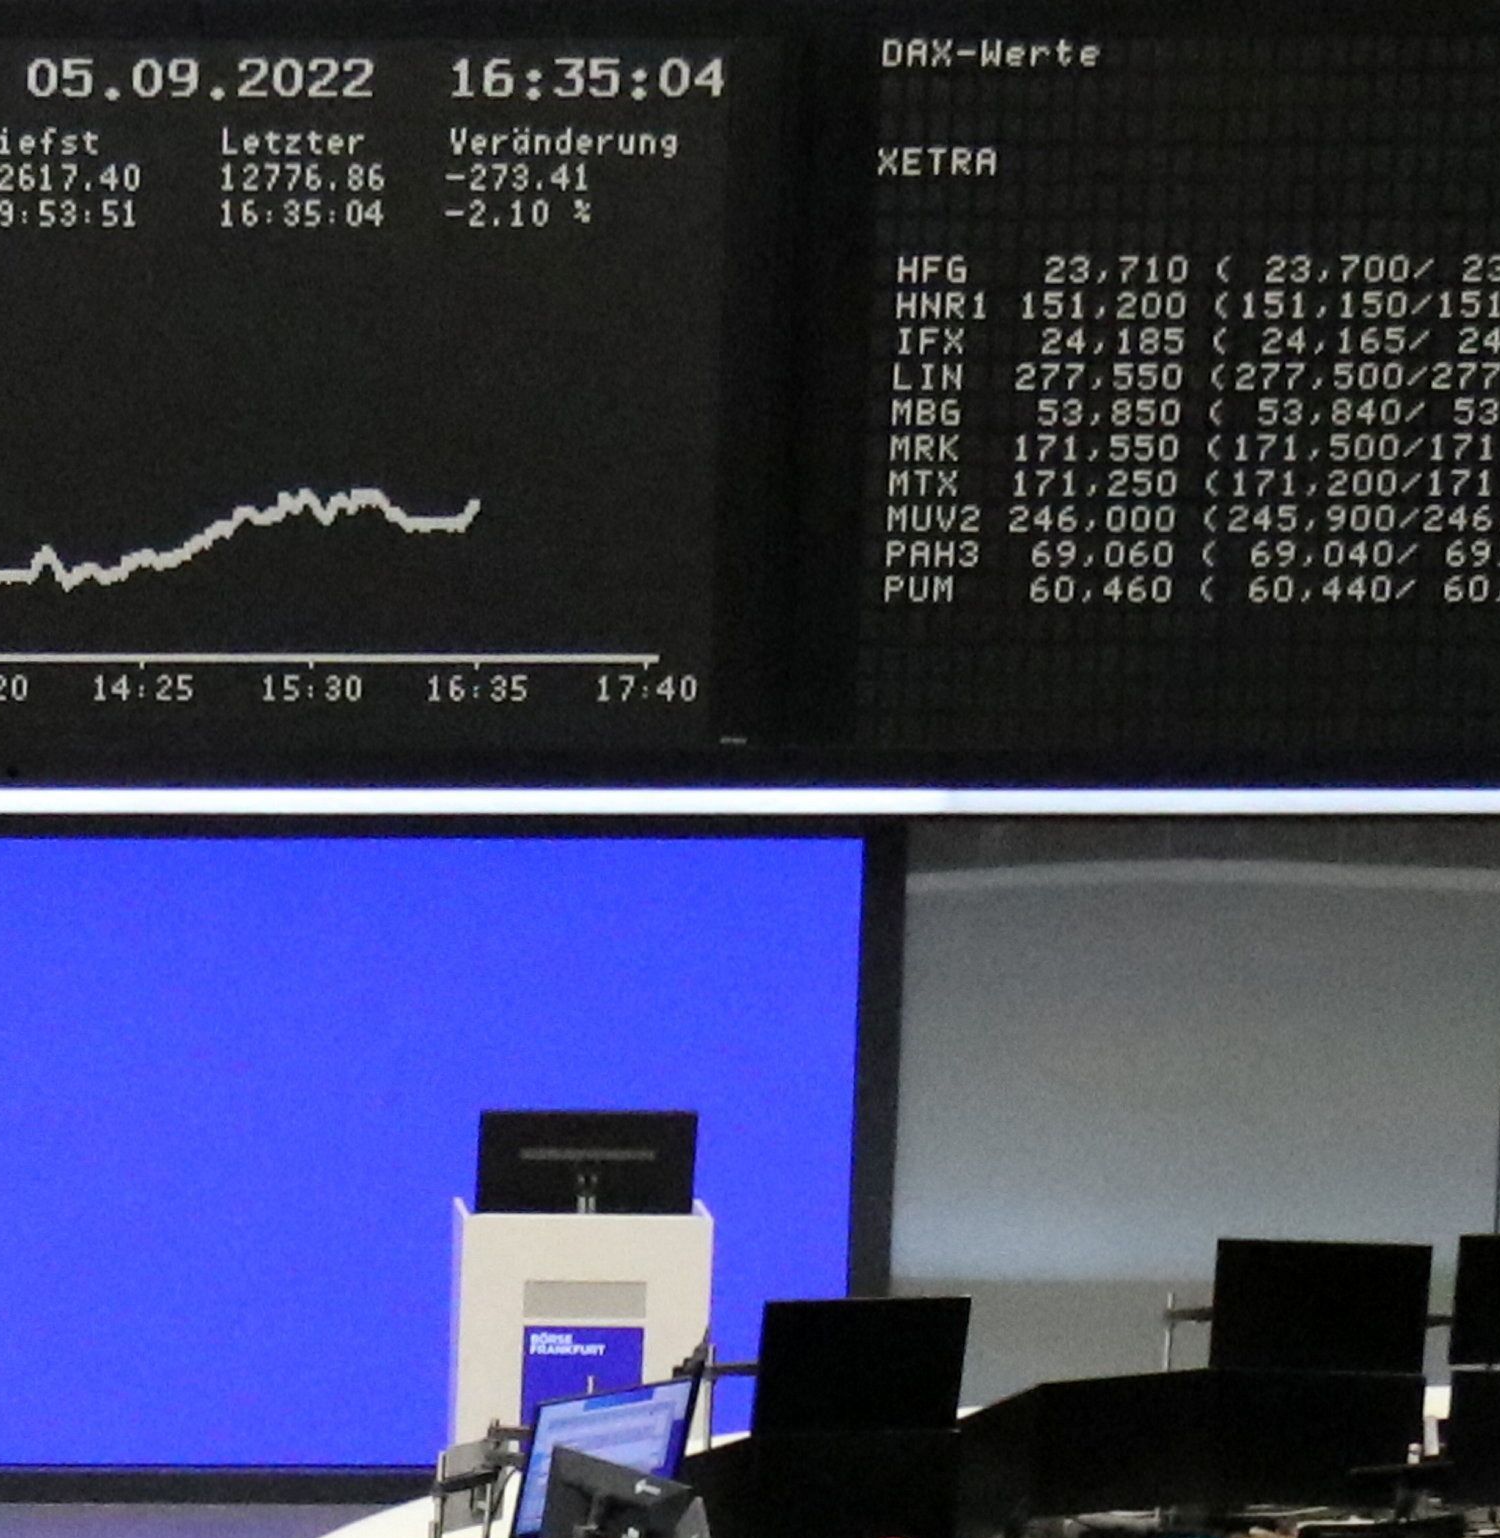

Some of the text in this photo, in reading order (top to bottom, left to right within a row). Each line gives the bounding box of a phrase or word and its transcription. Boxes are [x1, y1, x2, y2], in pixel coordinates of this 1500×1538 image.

[881, 37, 1100, 68] DAX-Werte
[27, 57, 374, 101] 05.09.2022
[451, 57, 725, 101] 16:35:04
[221, 126, 365, 156] Letzter
[450, 126, 678, 159] Veränderung
[877, 146, 997, 176] XETRA
[221, 162, 385, 192] 12776.86
[445, 162, 588, 192] -273.41
[221, 198, 384, 228] 16:35:04
[444, 198, 549, 228] -2.10
[573, 198, 591, 224] %
[897, 254, 1189, 284] HFG 23,710
[896, 291, 986, 320] HNR1
[1022, 290, 1187, 320] 151,200
[898, 326, 1185, 355] IFX 24,185
[892, 362, 963, 391] LIN
[1014, 362, 1183, 391] 277,550
[891, 397, 1181, 427] MBG 53,850
[889, 433, 960, 462] MRK
[1015, 433, 1179, 462] 171,550
[888, 468, 958, 497] MTX
[1013, 468, 1178, 498] 171,250
[886, 504, 981, 533] MUV2
[1008, 504, 1176, 533] 246,000
[885, 539, 1174, 568] PAH3 69,060
[884, 574, 1172, 603] PUM 60,460
[94, 673, 193, 701] 14:25
[262, 674, 362, 702] 15:30
[428, 674, 528, 702] 16:35
[597, 674, 698, 702] 17:40
[529, 1344, 606, 1356] FRANKFURT
[530, 1333, 573, 1344] BÖRSE
